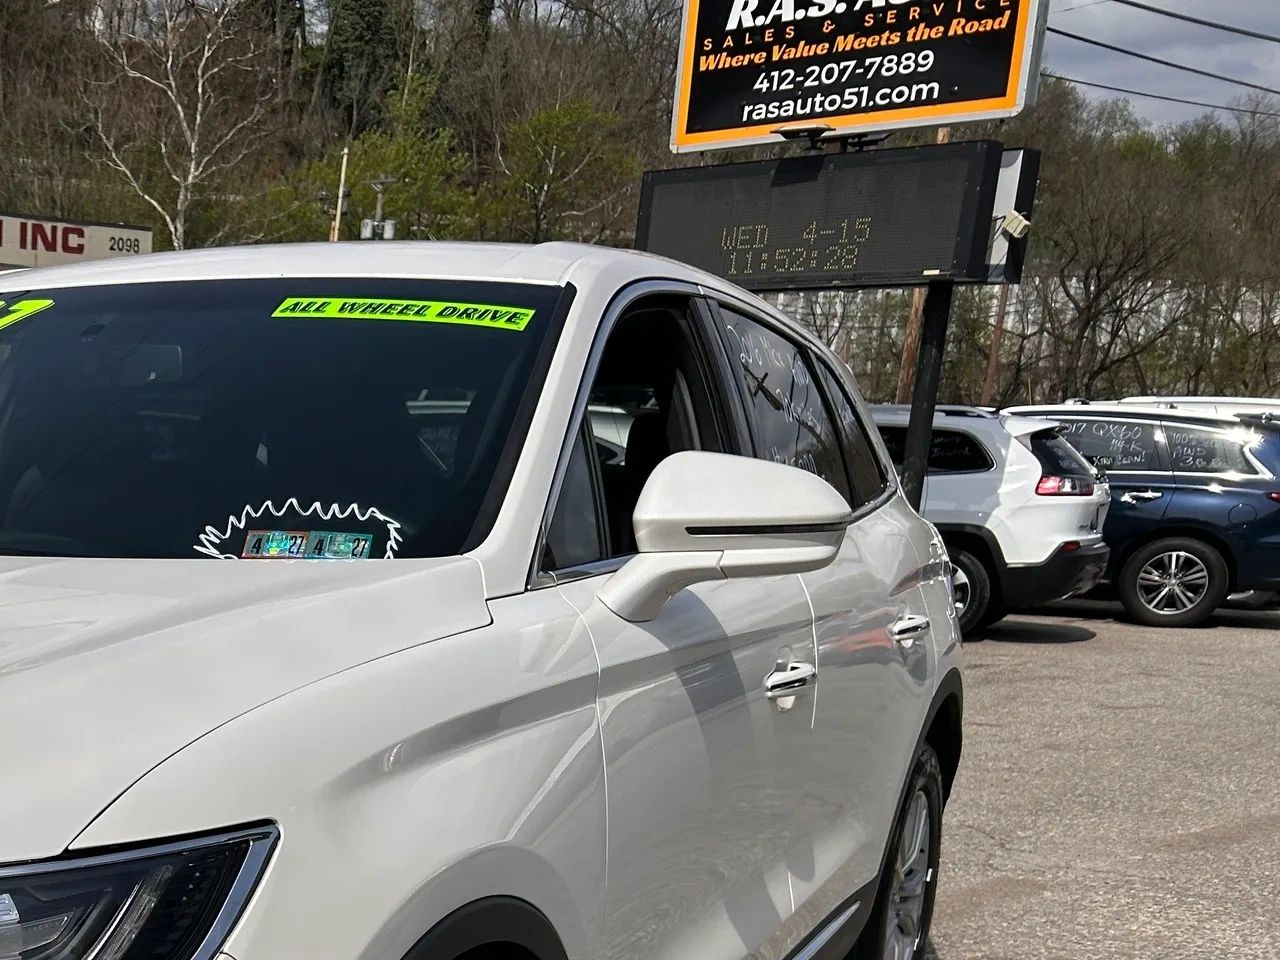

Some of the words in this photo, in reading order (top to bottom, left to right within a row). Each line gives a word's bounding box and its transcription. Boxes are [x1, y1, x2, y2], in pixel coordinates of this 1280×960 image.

[699, 51, 766, 72] Where
[772, 40, 829, 60] Value
[832, 31, 901, 53] Meets
[906, 22, 945, 41] the
[948, 10, 1011, 37] Road
[703, 26, 795, 50] SALES
[822, 20, 836, 33] &
[864, 0, 1010, 27] SERVICE
[752, 50, 935, 94] 412-207-7889
[742, 81, 940, 122] rasauto51.com
[19, 221, 86, 255] INC
[108, 236, 141, 254] 2098
[721, 224, 768, 250] WED
[802, 217, 872, 245] 4-15
[728, 245, 859, 274] 11:52:28
[280, 301, 332, 314] ALL
[337, 302, 432, 318] WHEEL
[435, 306, 530, 325] DRIVE
[252, 537, 263, 555] 4
[288, 535, 304, 554] 27
[314, 538, 325, 555] 4
[351, 537, 368, 557] 27
